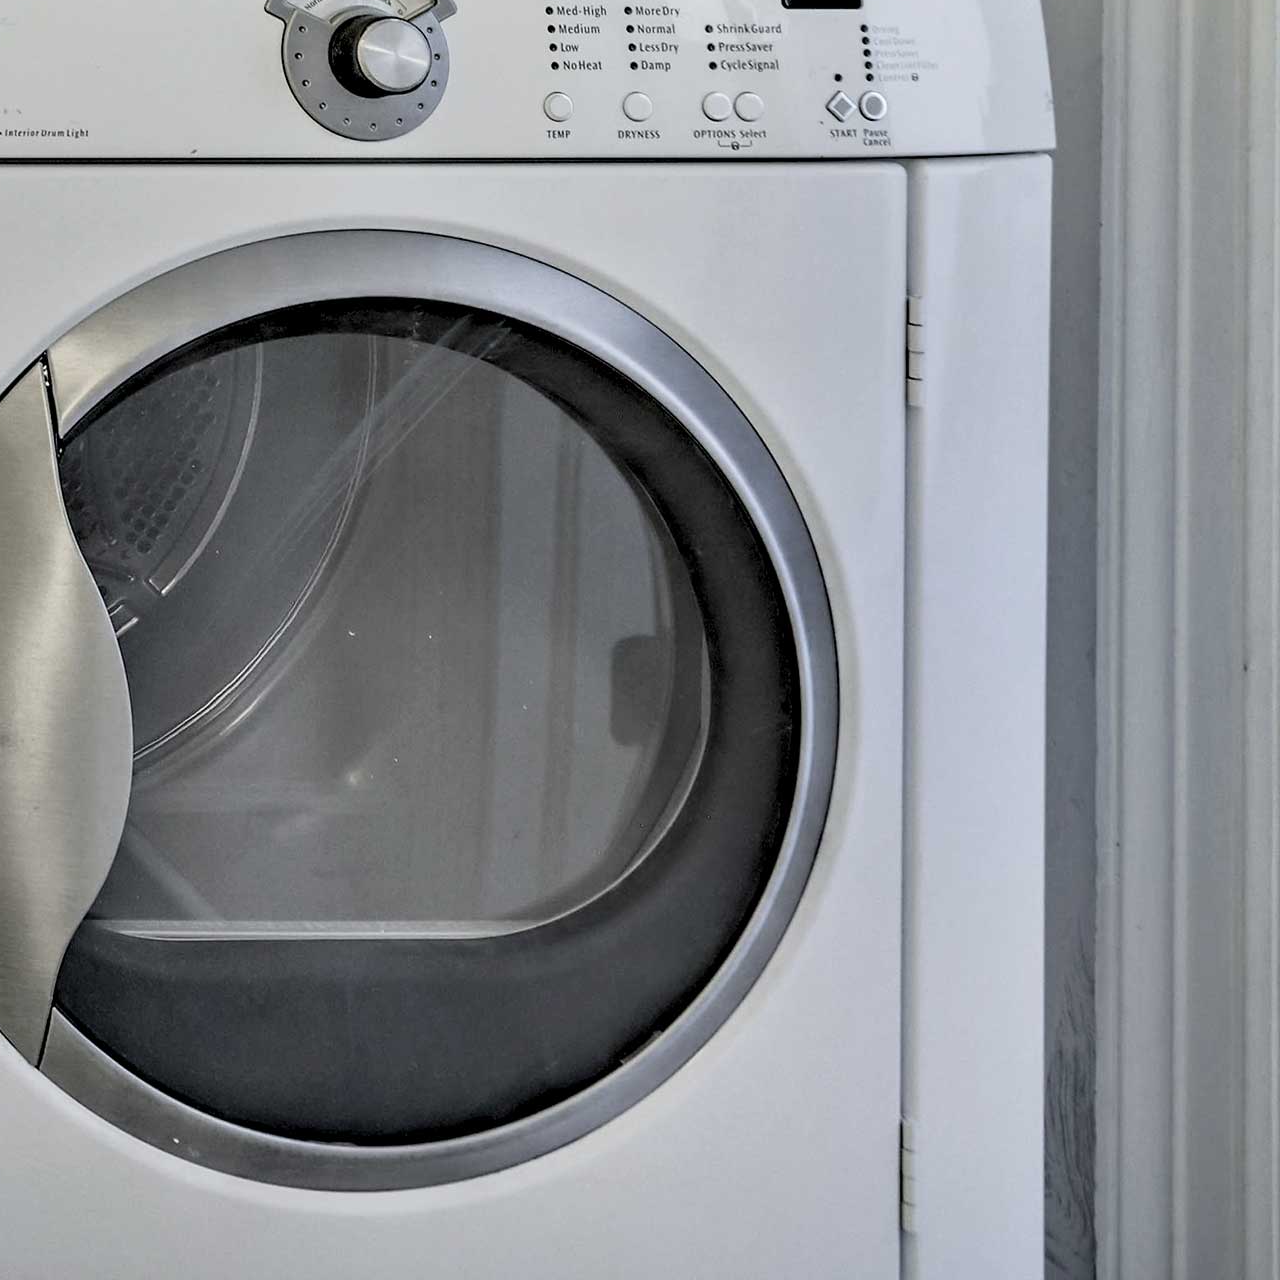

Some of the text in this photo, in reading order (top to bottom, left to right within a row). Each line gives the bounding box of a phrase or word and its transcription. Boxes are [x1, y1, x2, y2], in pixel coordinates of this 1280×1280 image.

[556, 5, 607, 18] Med-High
[558, 24, 600, 34] Medium
[637, 24, 676, 34] Normal
[560, 42, 579, 52] Low
[641, 61, 671, 72] Damp
[5, 128, 40, 137] Interior
[41, 128, 65, 137] Drum
[66, 128, 89, 138] Light
[546, 130, 571, 139] TEMP
[617, 130, 661, 140] DRYNESS
[693, 129, 767, 139] OPTIONS Select
[829, 128, 857, 138] START
[863, 129, 888, 138] Pause
[863, 137, 891, 147] Cancel
